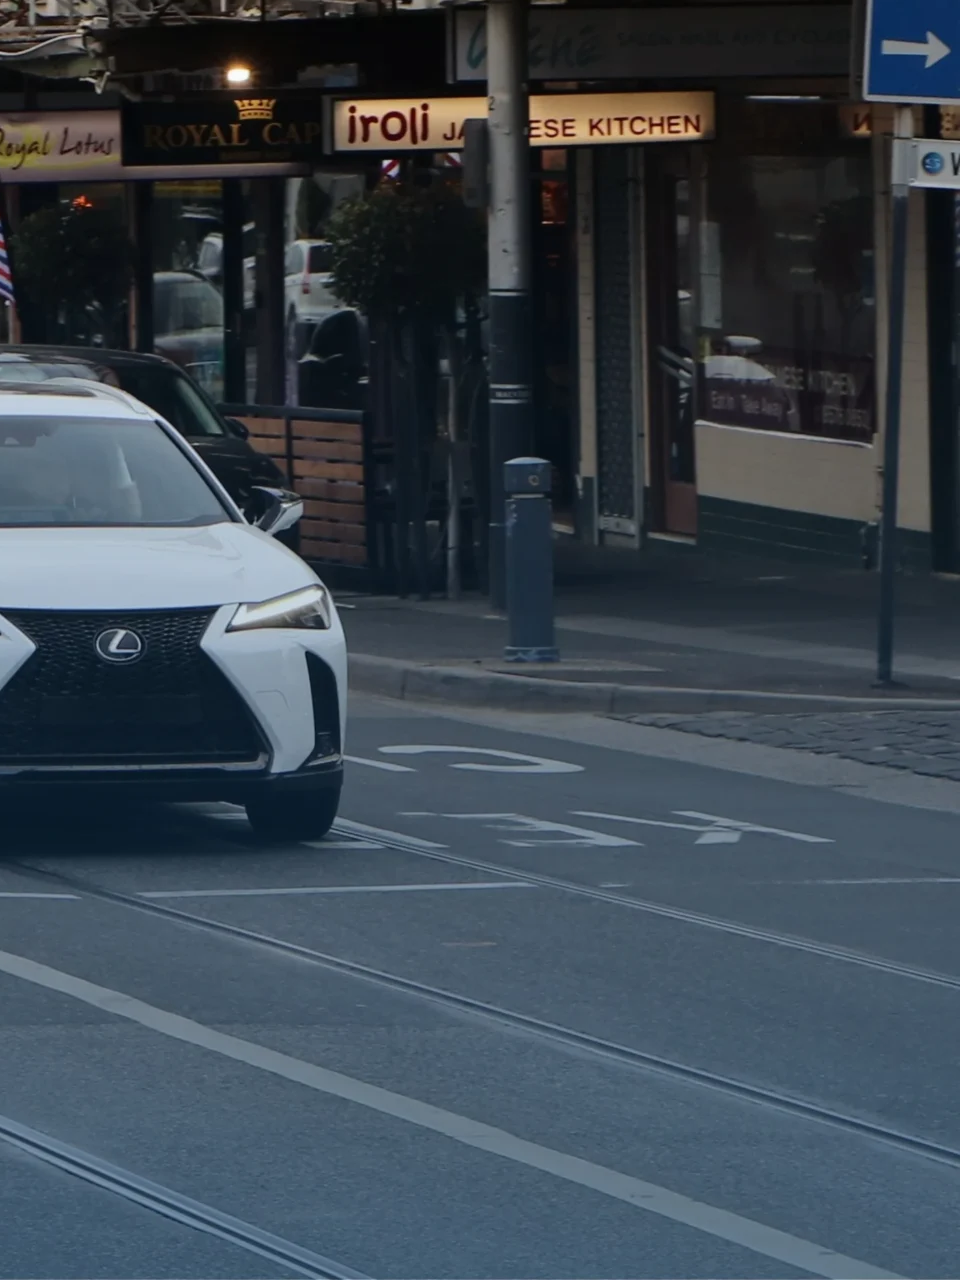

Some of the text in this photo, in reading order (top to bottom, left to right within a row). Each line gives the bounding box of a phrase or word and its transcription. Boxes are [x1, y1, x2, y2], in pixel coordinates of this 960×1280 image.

[143, 122, 321, 152] ROYAL CAP
[589, 114, 702, 137] KITCHEN
[59, 126, 113, 156] Lotus
